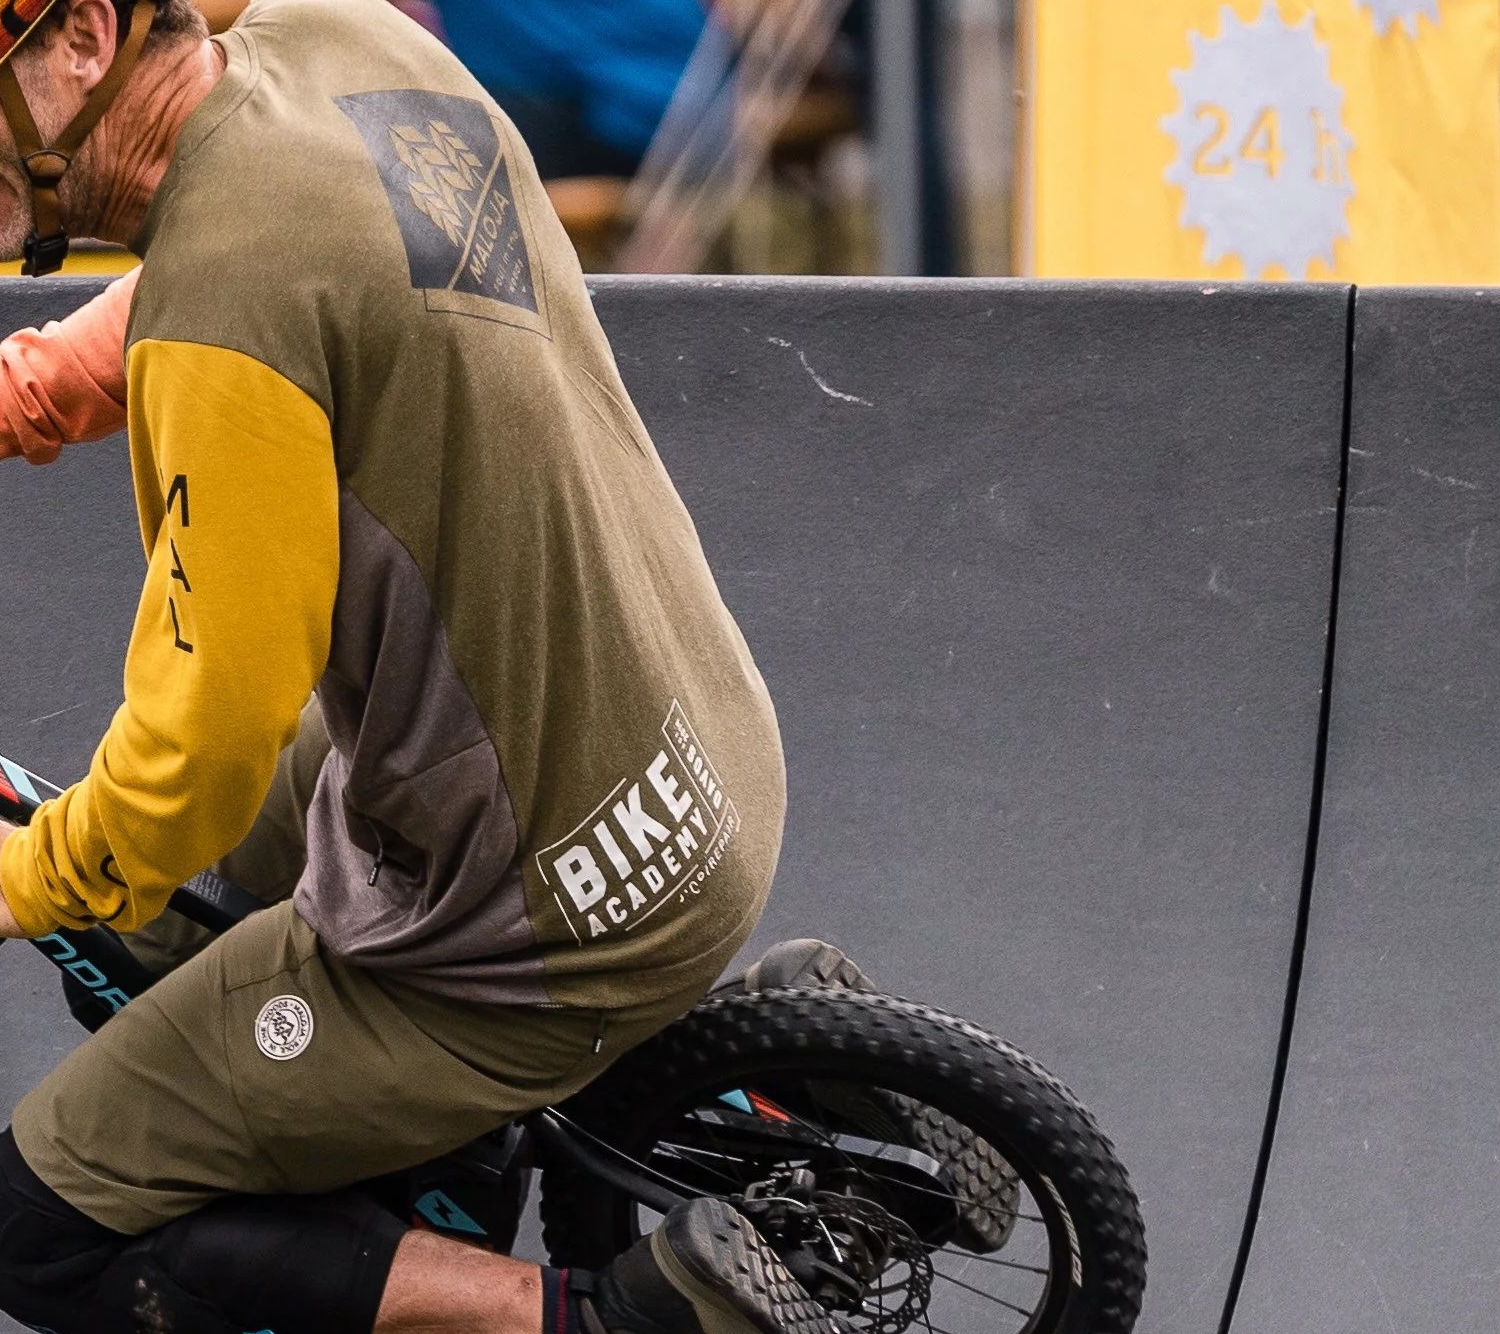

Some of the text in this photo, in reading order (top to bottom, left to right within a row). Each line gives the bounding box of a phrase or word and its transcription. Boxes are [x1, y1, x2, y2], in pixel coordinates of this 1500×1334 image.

[470, 189, 509, 284] MALOJA
[553, 750, 694, 913] BIKE
[588, 807, 708, 938] ACADEMY
